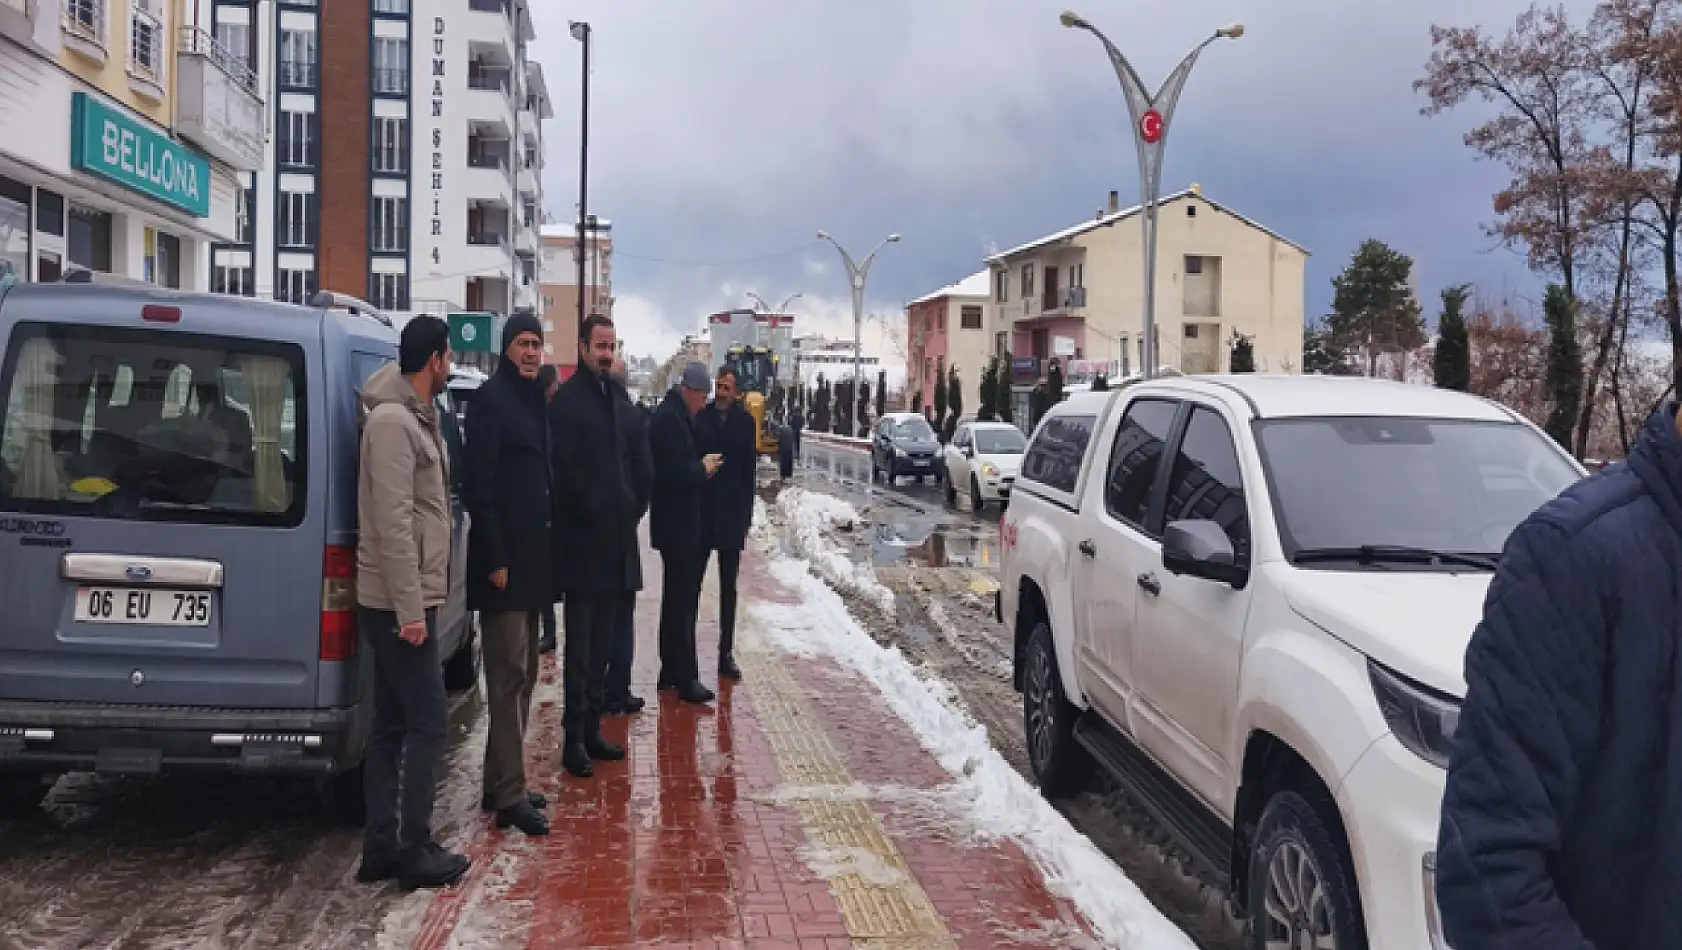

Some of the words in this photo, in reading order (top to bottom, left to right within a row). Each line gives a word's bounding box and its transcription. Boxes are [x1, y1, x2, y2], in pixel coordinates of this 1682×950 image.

[431, 15, 445, 117] DUMAN
[102, 119, 199, 202] BELLONA
[431, 246, 441, 265] 4
[89, 590, 113, 618] 06
[126, 590, 151, 619] EU
[171, 593, 209, 621] 735
